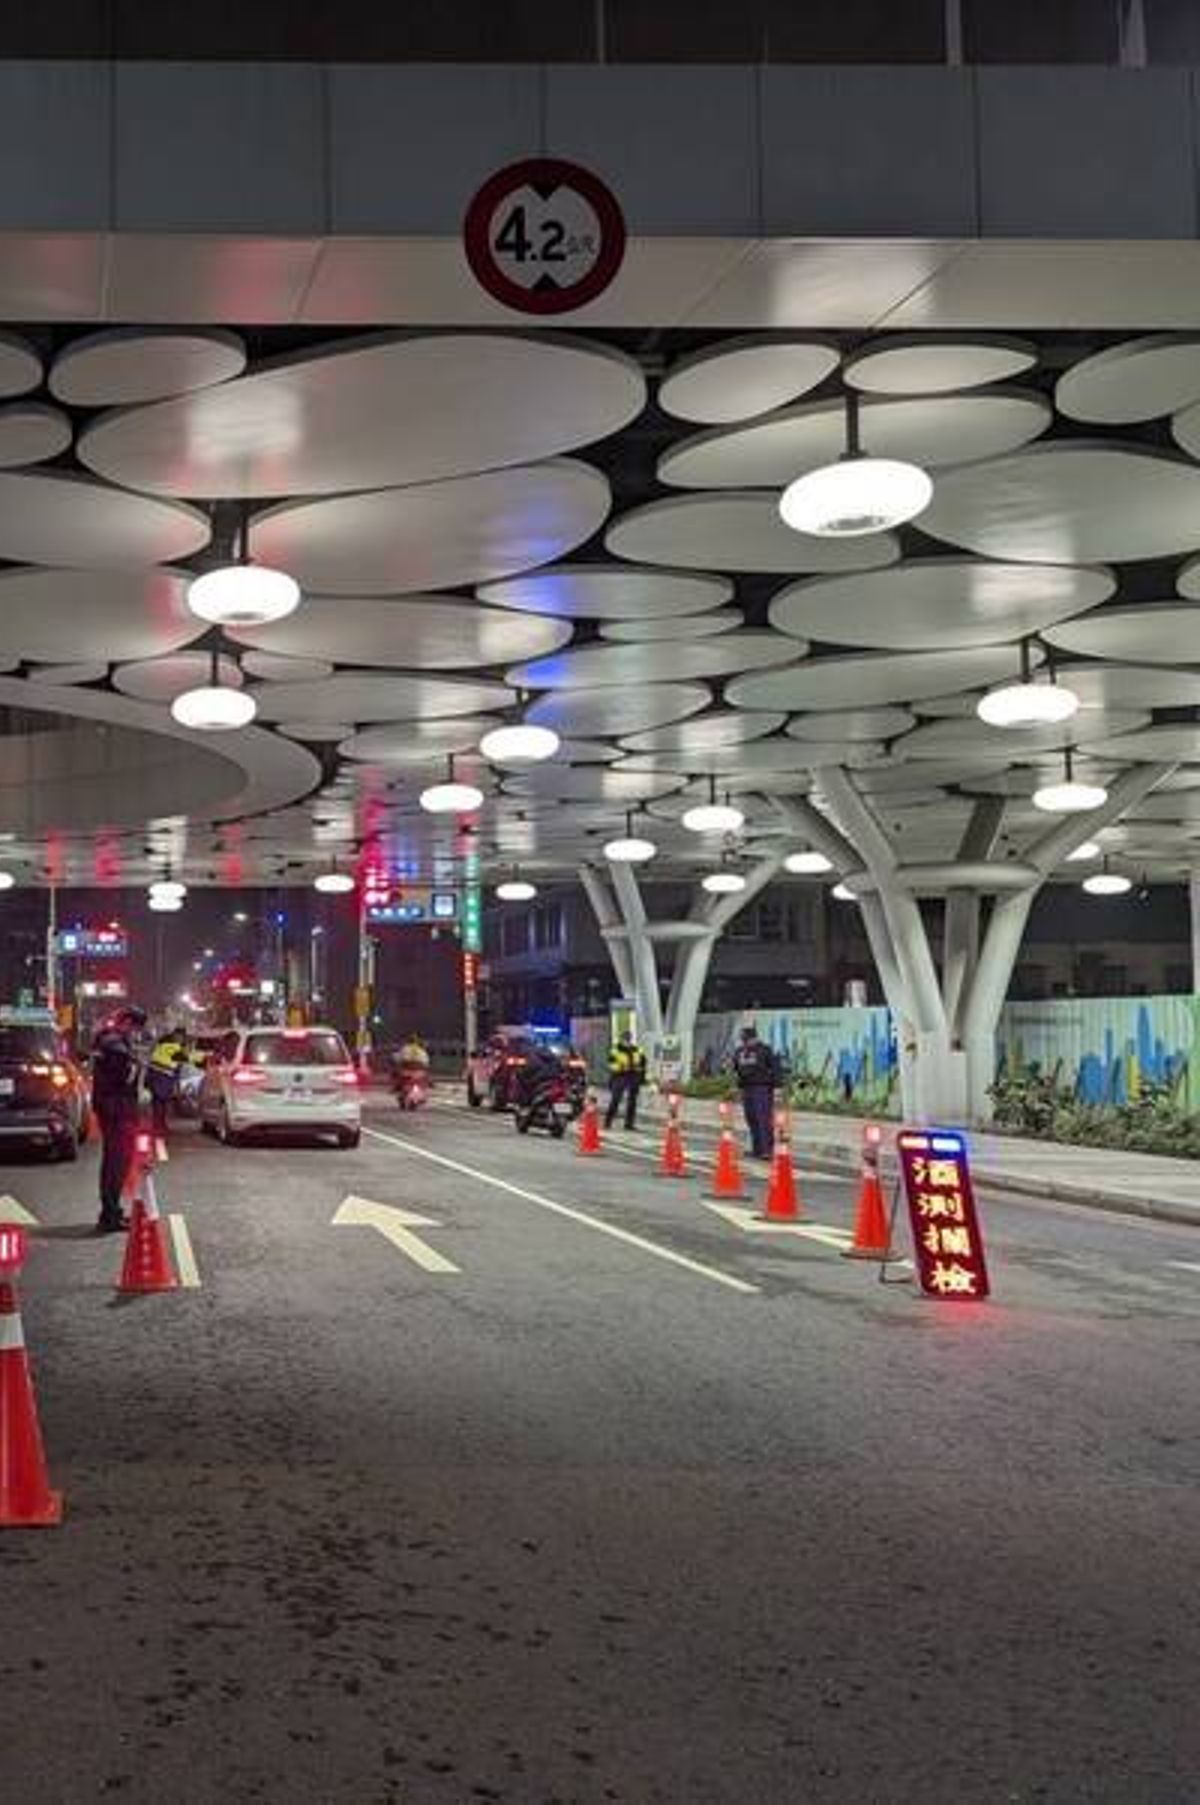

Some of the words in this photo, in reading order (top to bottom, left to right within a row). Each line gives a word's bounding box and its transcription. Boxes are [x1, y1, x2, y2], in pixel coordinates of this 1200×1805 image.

[495, 205, 567, 263] 4.2
[911, 1156, 977, 1294] 酒測攔檢
